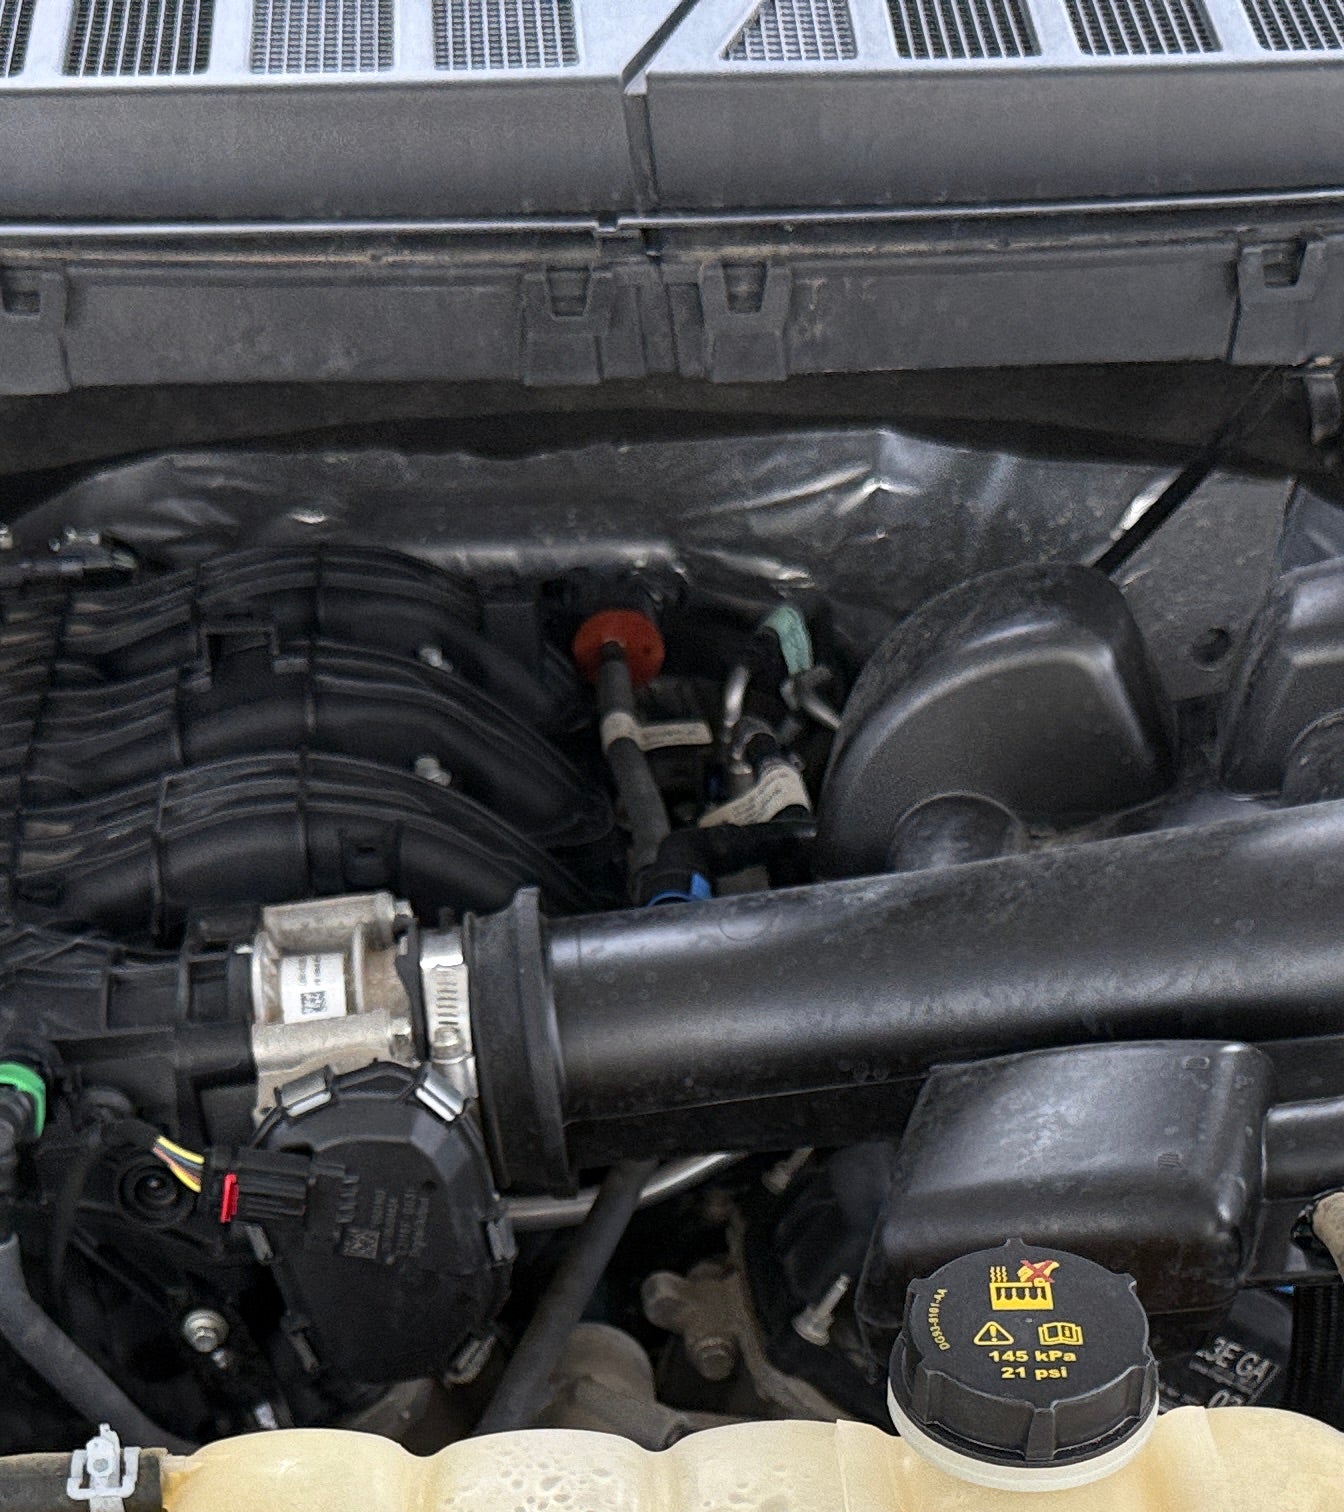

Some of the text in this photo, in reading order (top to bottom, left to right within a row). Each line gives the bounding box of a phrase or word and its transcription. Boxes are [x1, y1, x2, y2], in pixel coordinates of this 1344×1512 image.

[988, 1350, 1077, 1363] 145 kPa
[1000, 1366, 1068, 1381] 21 psi
